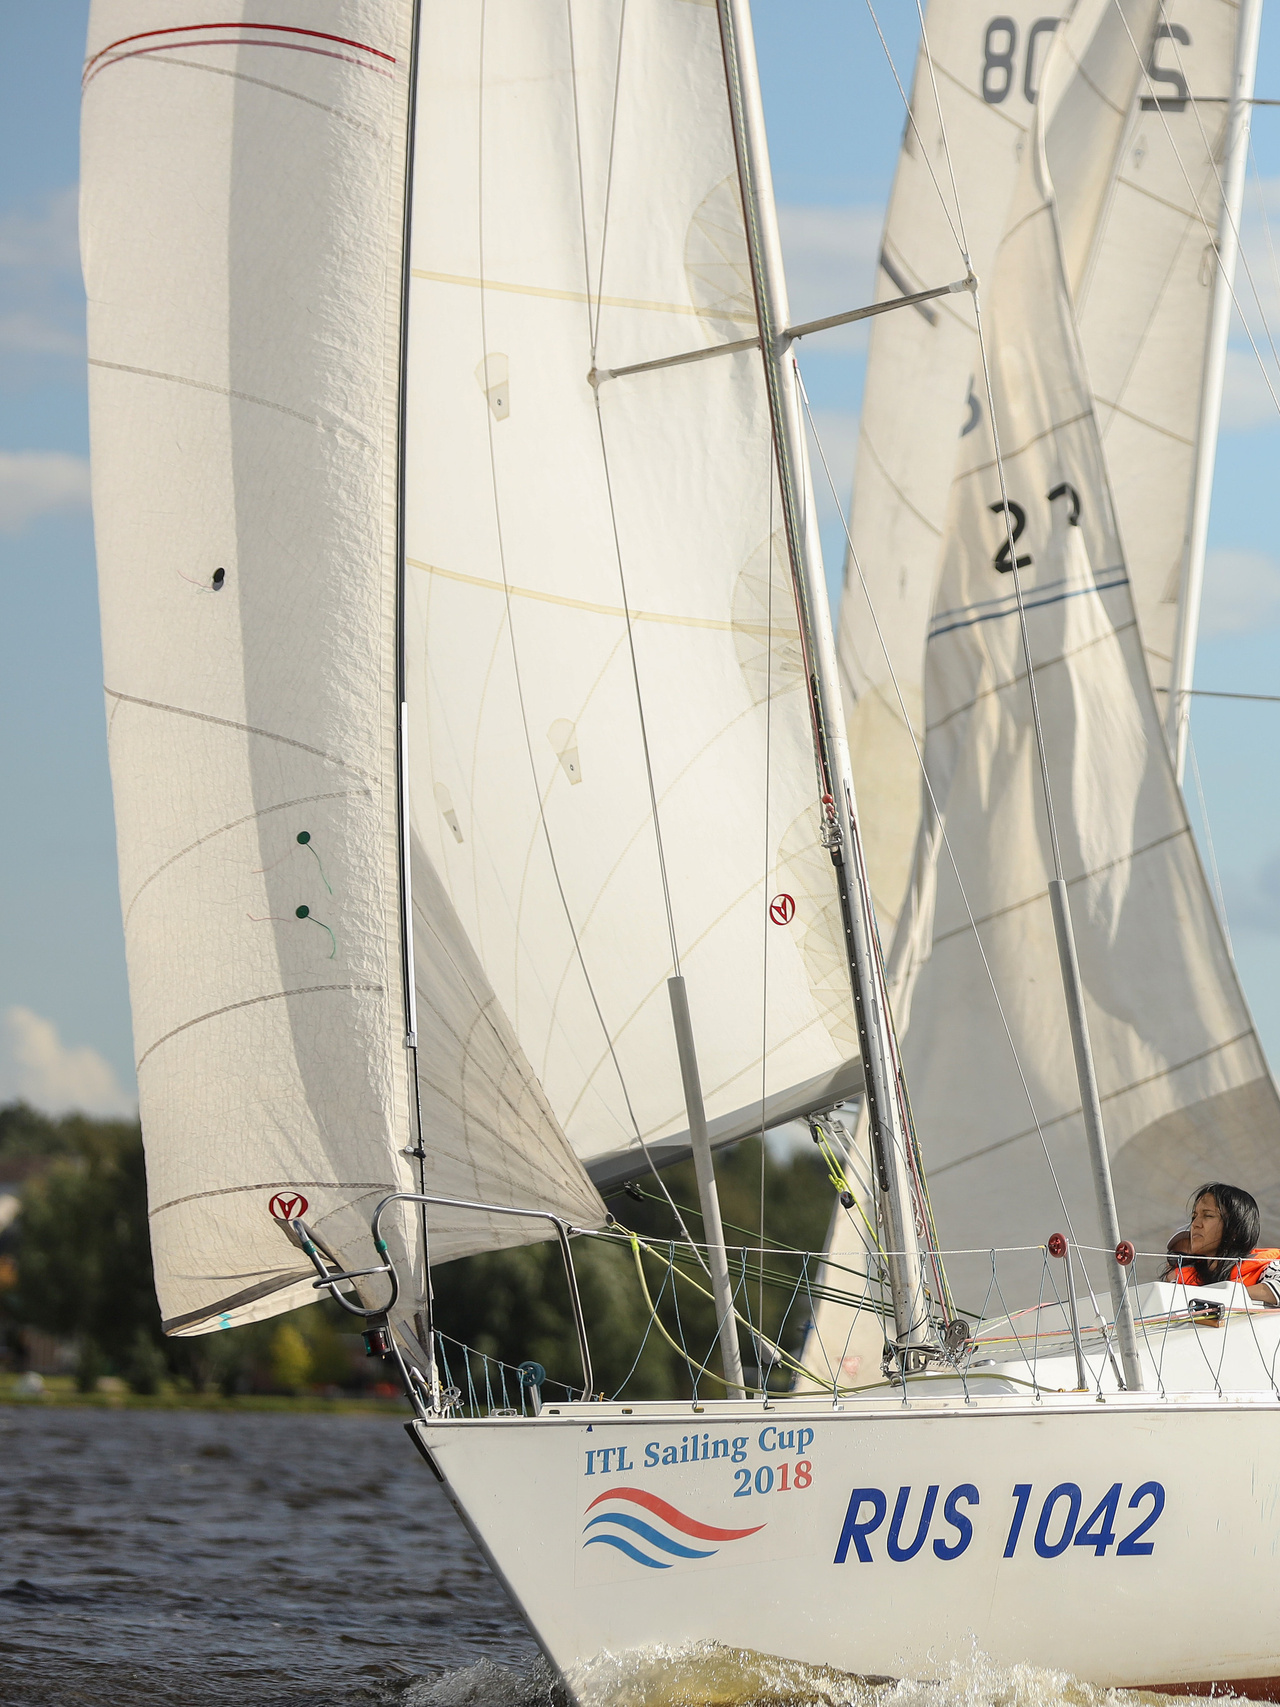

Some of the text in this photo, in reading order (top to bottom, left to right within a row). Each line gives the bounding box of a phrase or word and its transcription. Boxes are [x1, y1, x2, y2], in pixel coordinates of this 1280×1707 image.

[584, 1426, 815, 1476] ITL Sailing Cup
[733, 1460, 813, 1498] 2018
[833, 1480, 1166, 1564] RUS 1042
